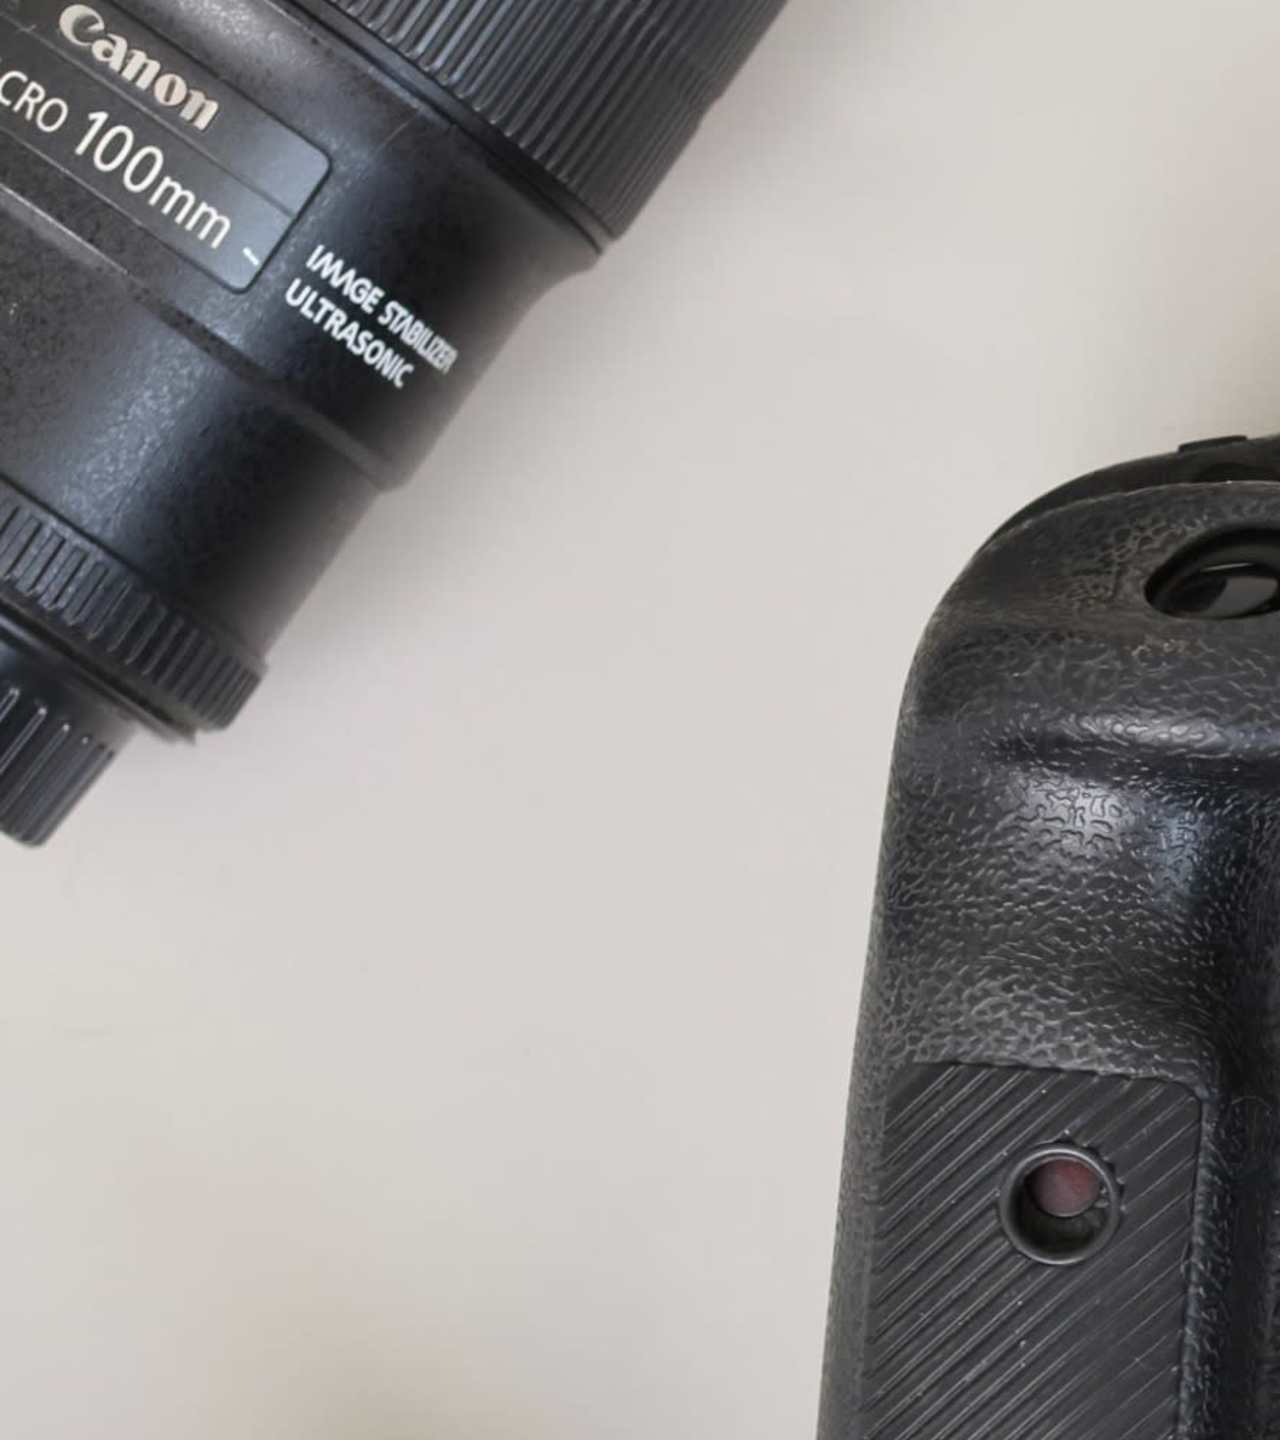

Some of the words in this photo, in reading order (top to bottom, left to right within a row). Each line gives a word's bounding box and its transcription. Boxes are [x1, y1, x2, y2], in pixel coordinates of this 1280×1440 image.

[59, 4, 219, 131] Canon
[74, 110, 231, 250] 100mm
[284, 277, 415, 389] ULTRASONIC
[305, 244, 385, 315] IMAGE
[377, 300, 458, 374] STABILIZER
